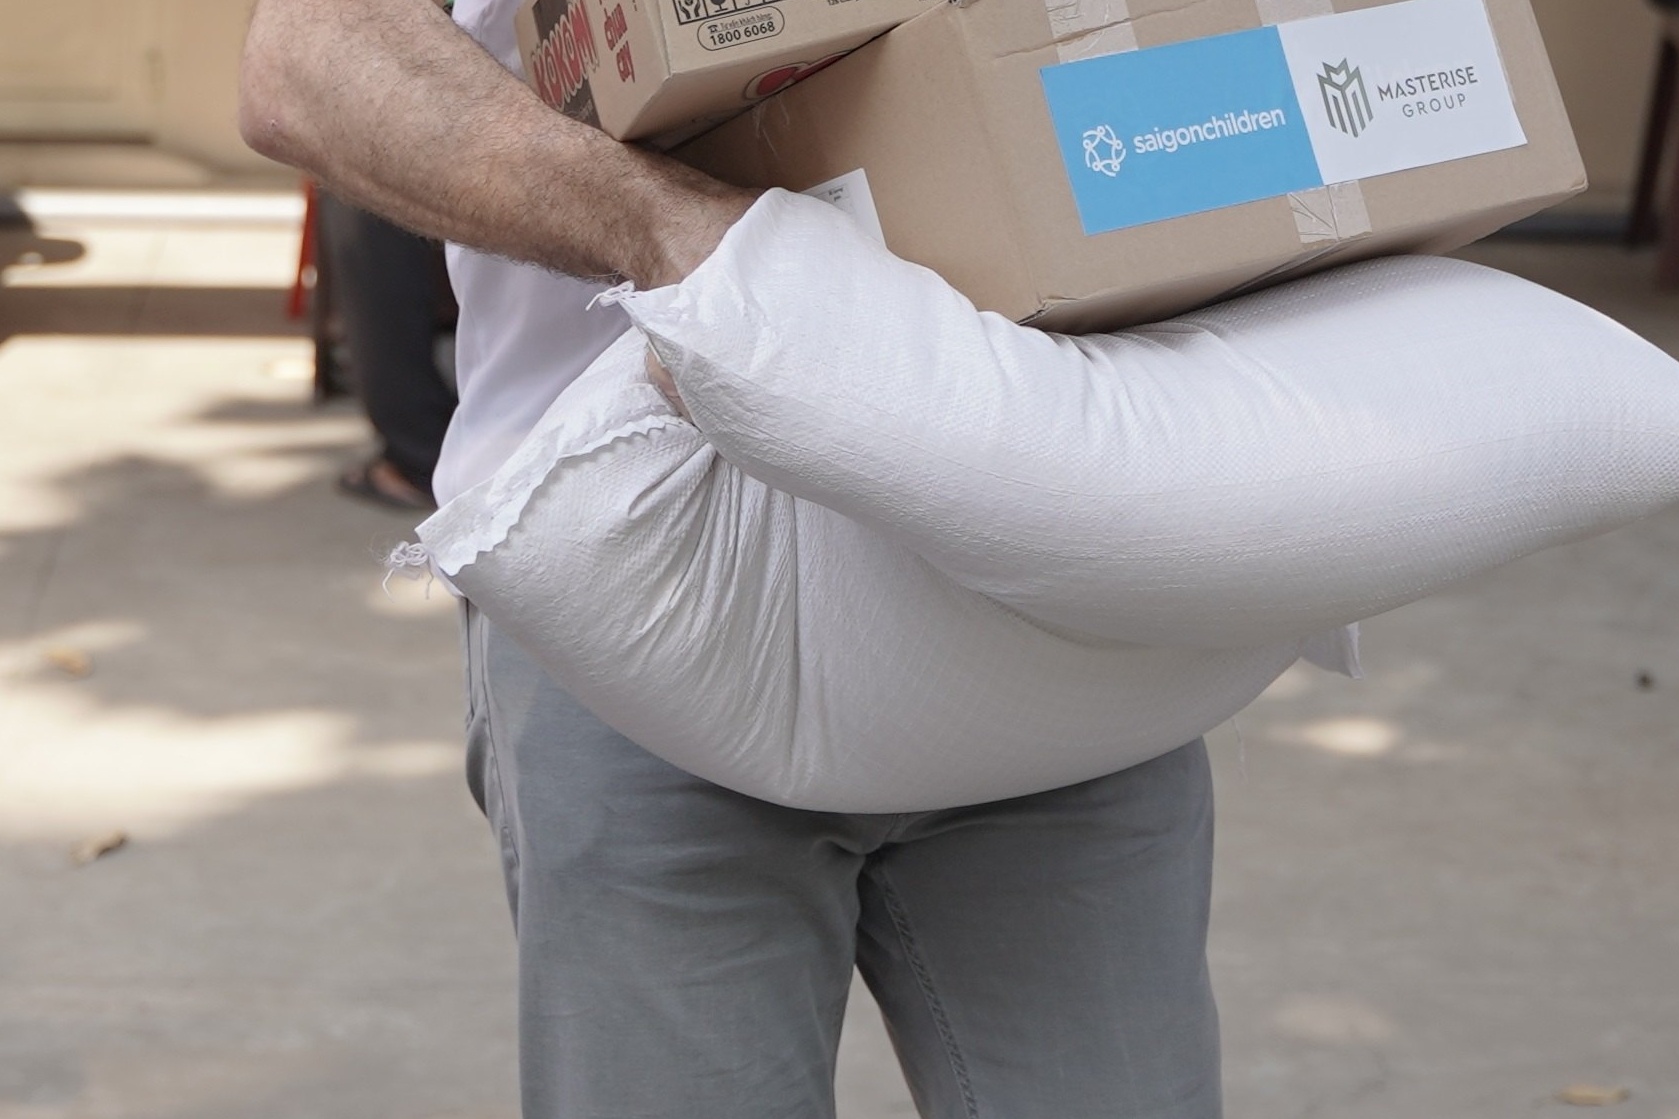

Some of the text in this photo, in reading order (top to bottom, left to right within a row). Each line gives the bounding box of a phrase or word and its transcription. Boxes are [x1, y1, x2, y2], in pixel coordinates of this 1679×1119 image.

[710, 21, 775, 46] 1800 6068
[1377, 65, 1479, 102] MASTERISE
[1402, 92, 1467, 118] GROUP
[1133, 106, 1286, 155] saigonchildren
